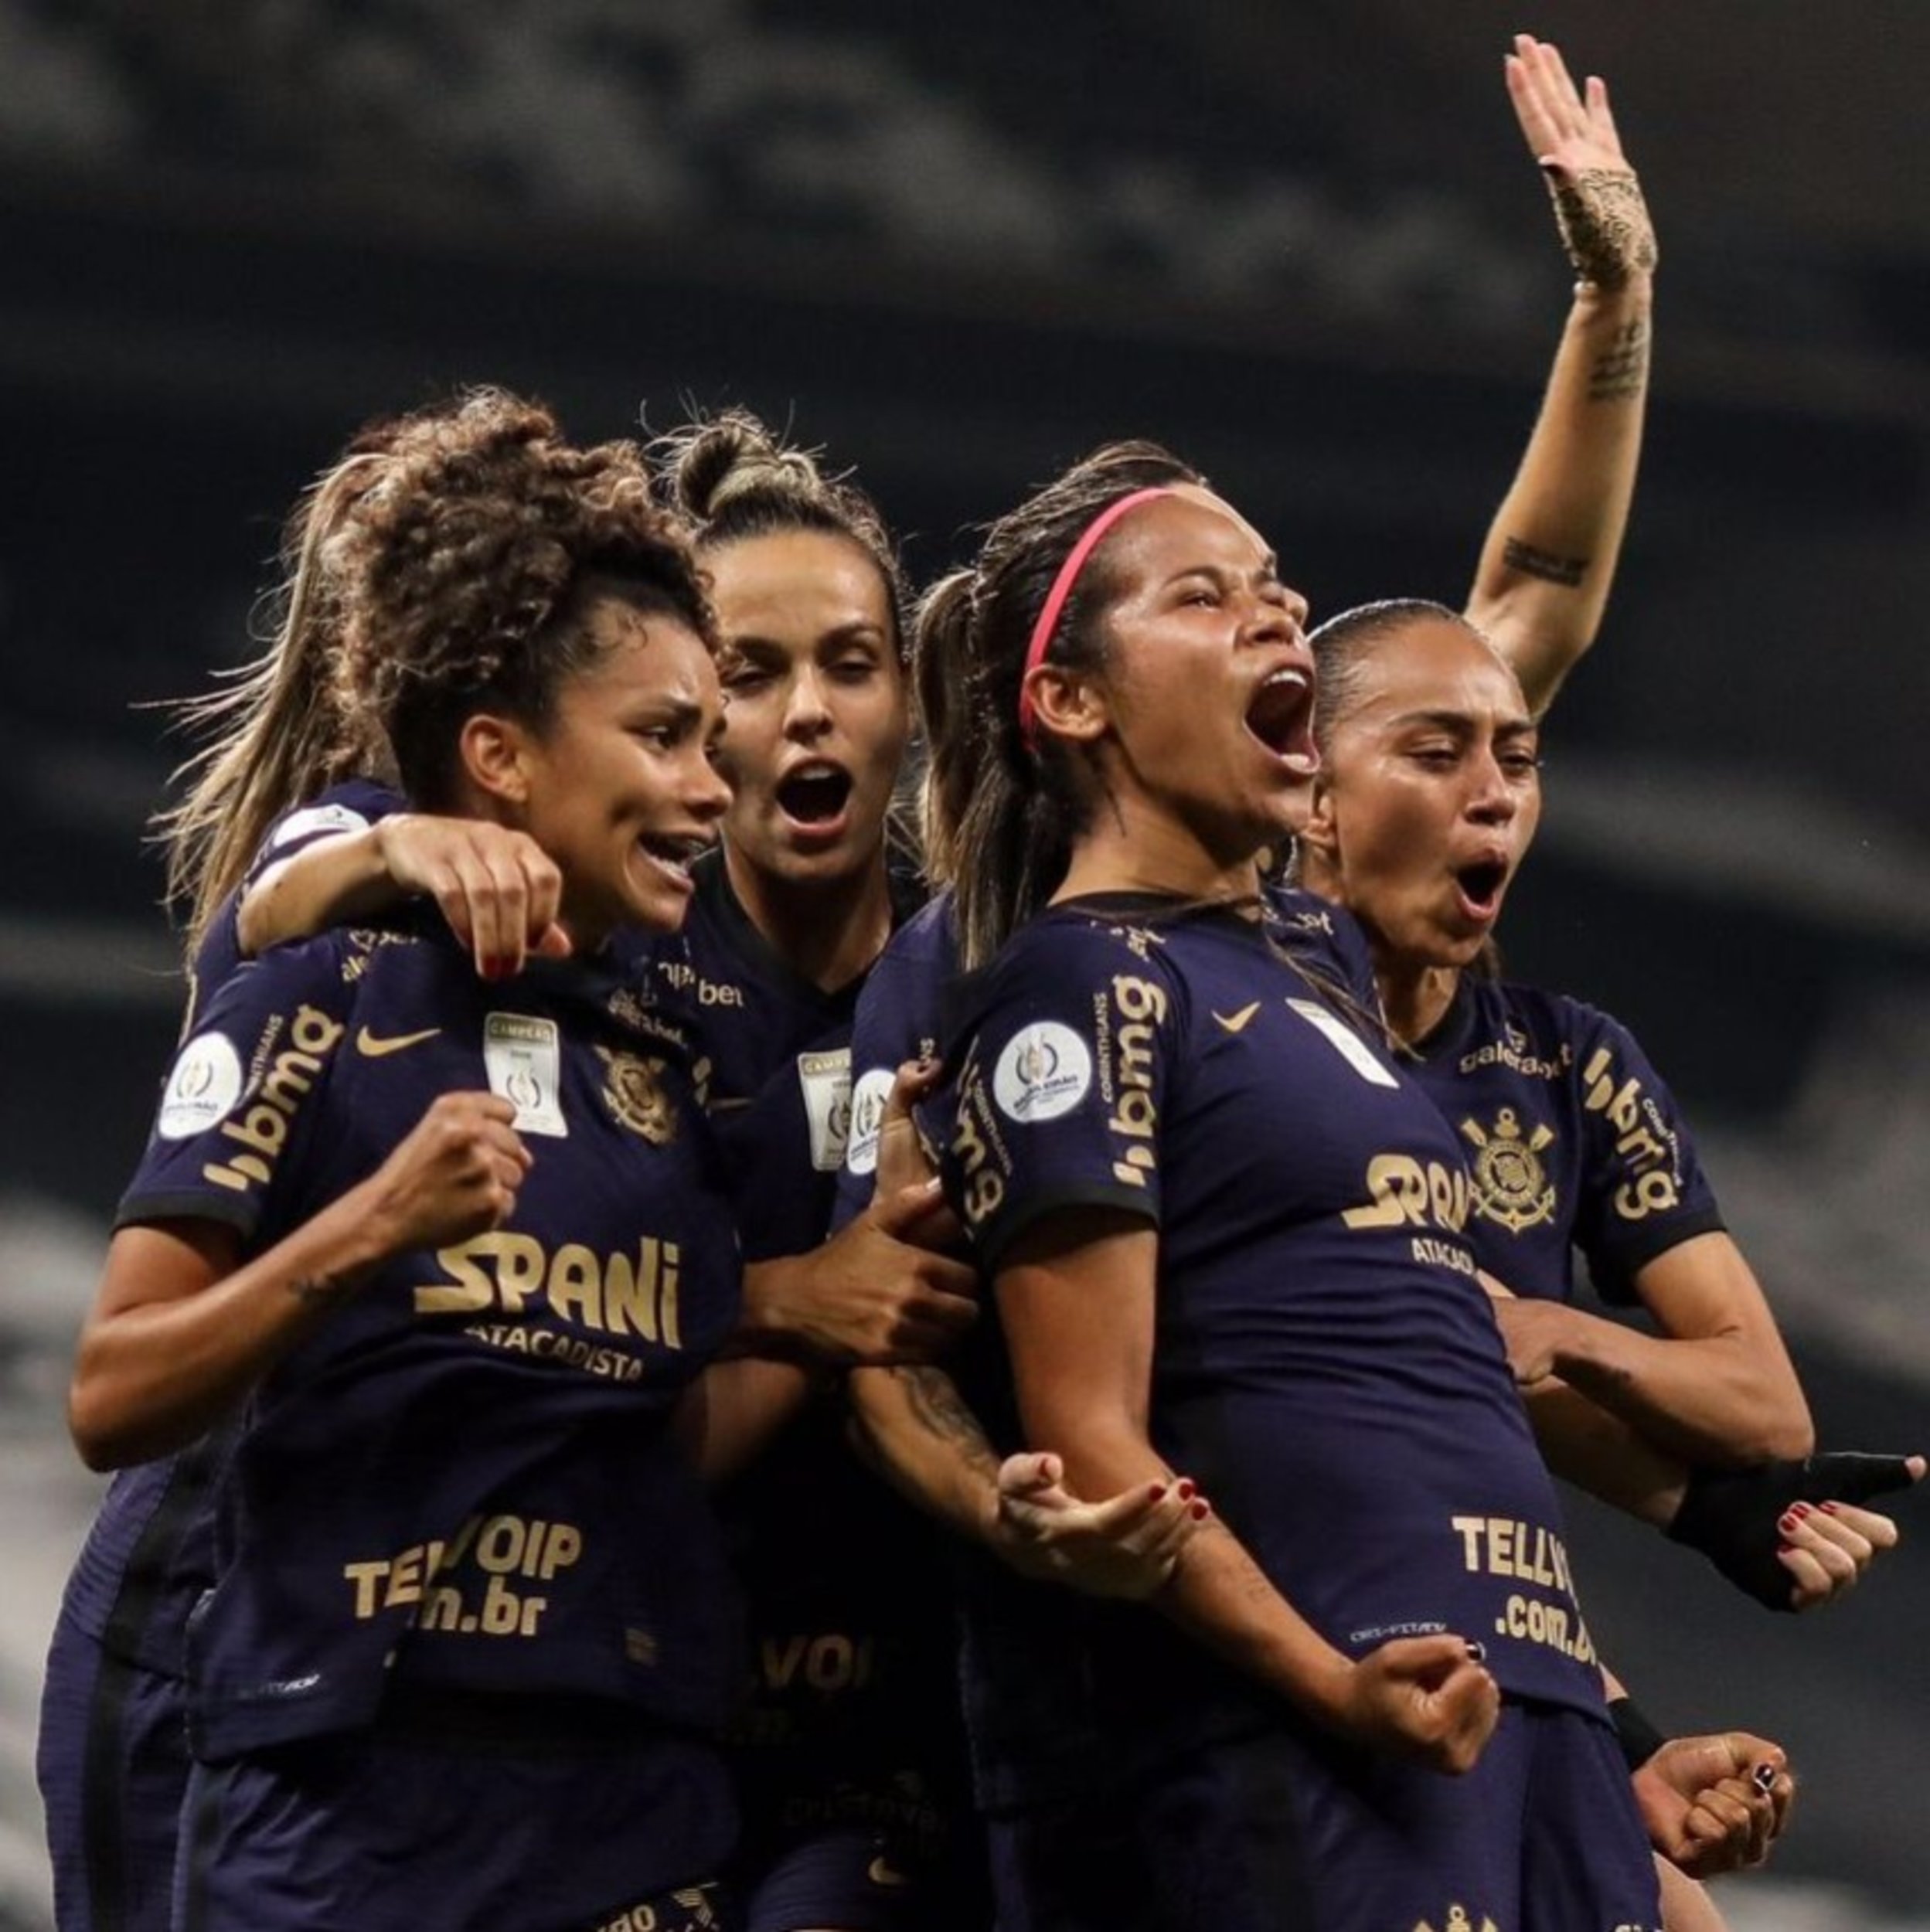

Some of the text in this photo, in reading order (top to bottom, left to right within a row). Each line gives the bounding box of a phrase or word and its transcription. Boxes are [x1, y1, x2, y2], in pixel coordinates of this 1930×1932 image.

[221, 1005, 345, 1157] bmg
[1093, 992, 1112, 1103] CORINTHIANS
[1109, 975, 1167, 1137] bmg
[1495, 1594, 1596, 1665] .com.b
